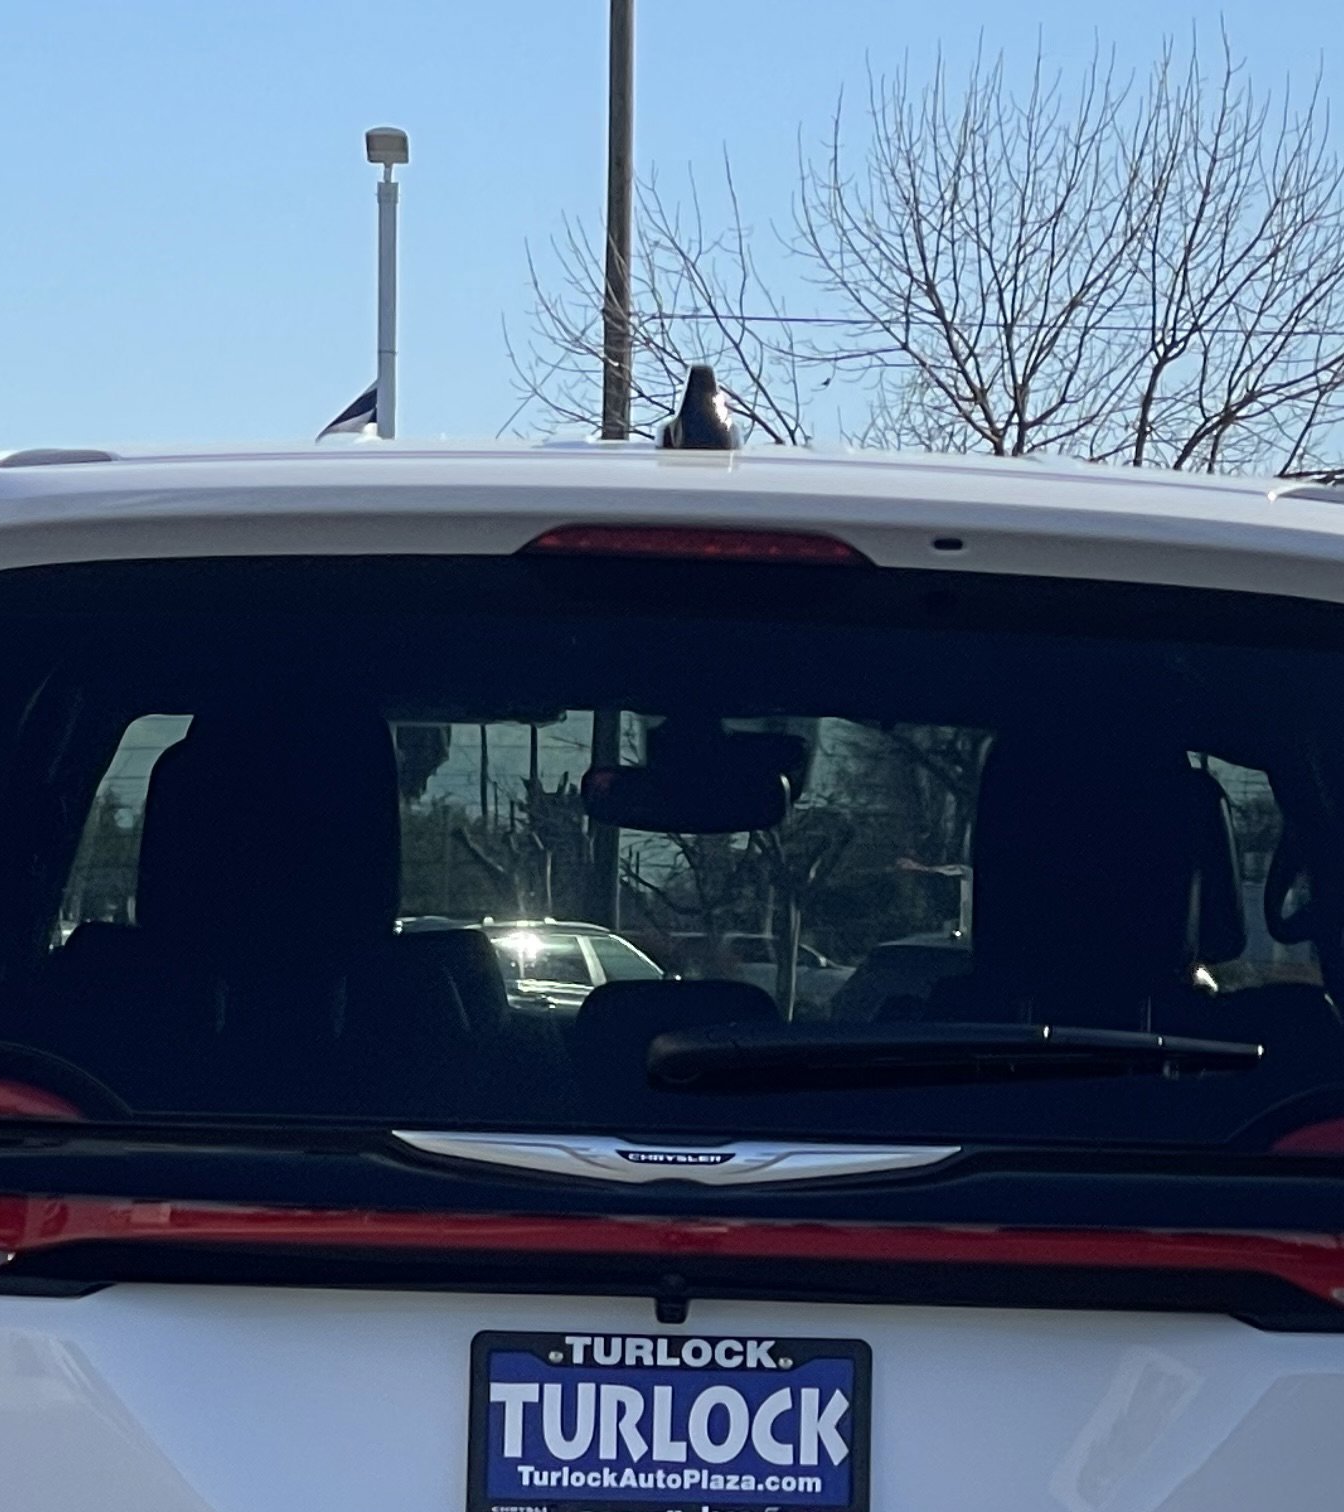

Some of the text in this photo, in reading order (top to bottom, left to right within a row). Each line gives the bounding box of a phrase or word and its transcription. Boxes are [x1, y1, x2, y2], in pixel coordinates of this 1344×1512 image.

[565, 1335, 777, 1370] TURLOCK
[489, 1382, 850, 1467] TURLOCK
[517, 1465, 822, 1494] TurlockAutoPlaza.com
